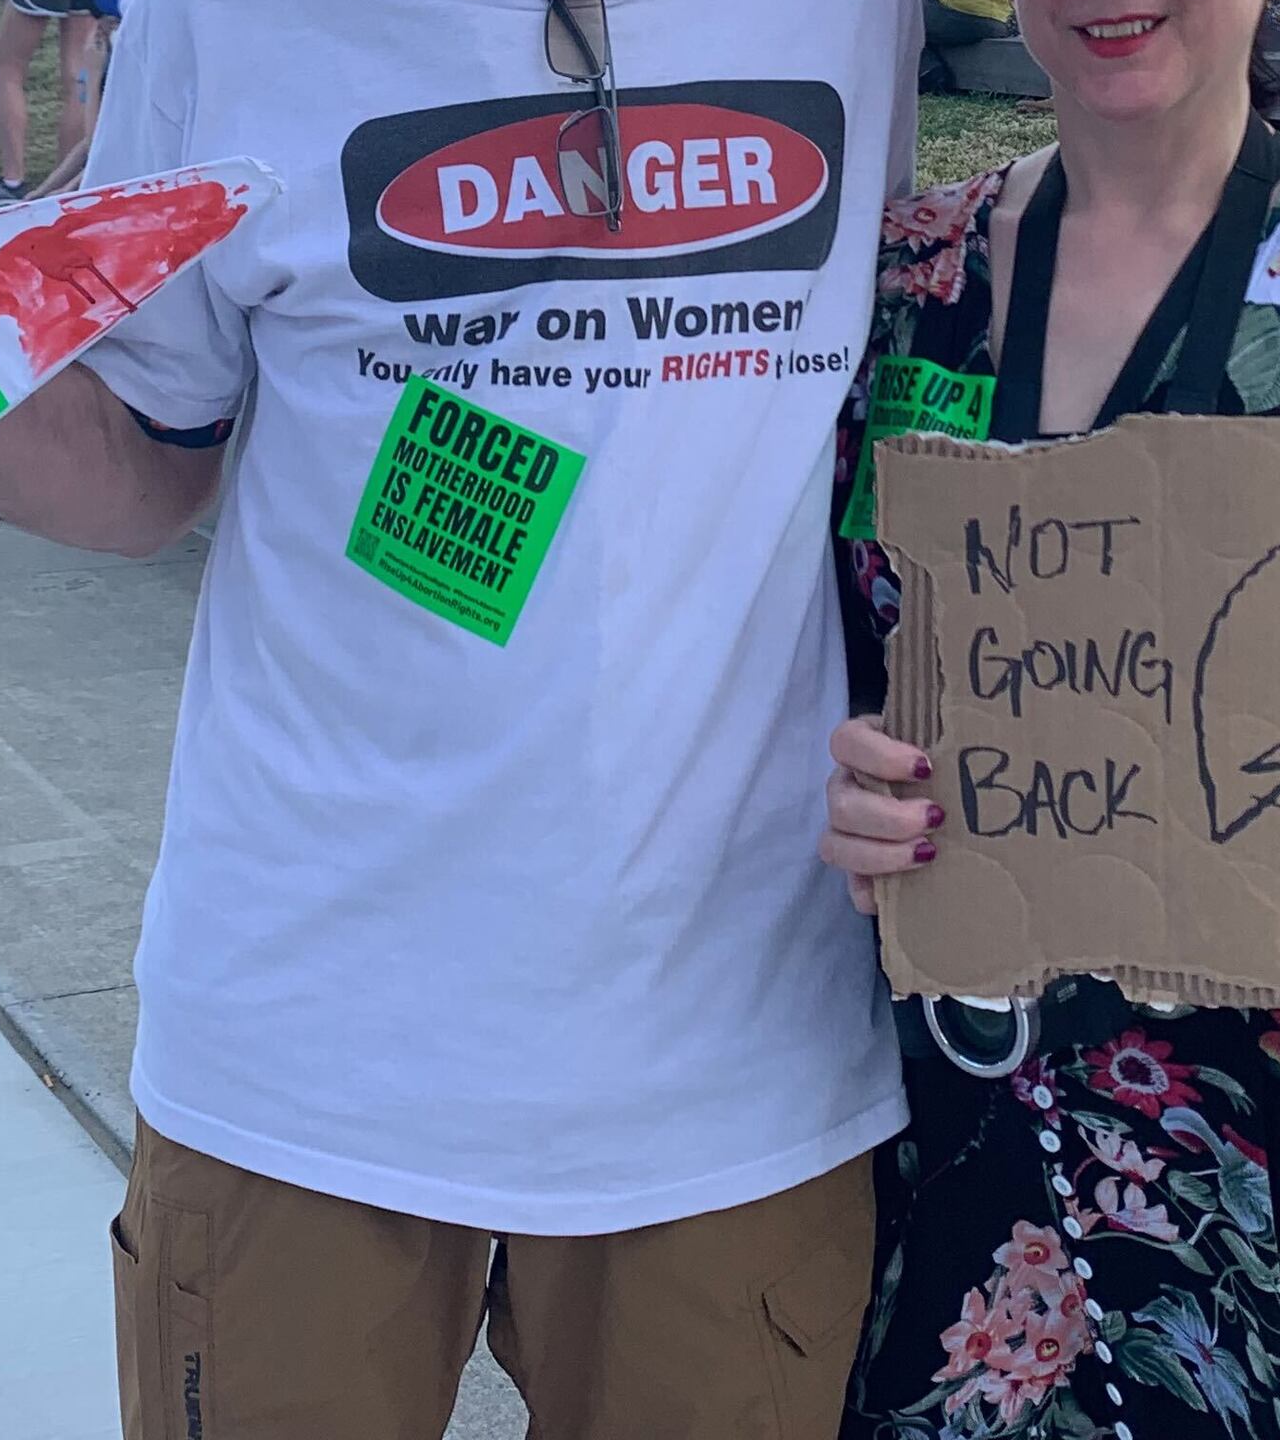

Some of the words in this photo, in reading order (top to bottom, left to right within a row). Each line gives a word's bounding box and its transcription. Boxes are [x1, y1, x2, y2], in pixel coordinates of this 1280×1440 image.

[436, 135, 778, 235] DANGER
[357, 348, 413, 384] You
[491, 358, 572, 388] have
[584, 363, 651, 394] your
[661, 348, 770, 383] RIGHTS
[789, 345, 849, 375] lose!
[403, 310, 520, 347] War
[536, 308, 607, 341] on
[876, 363, 922, 403] RISE
[921, 372, 966, 413] UP
[967, 383, 984, 423] 4
[392, 435, 537, 525] MOTHERHOOD
[408, 387, 560, 494] FORCED
[370, 502, 514, 594] ENSLAVEMENT
[380, 466, 412, 507] IS
[413, 486, 529, 565] FEMALE
[963, 504, 1142, 595] NOT
[968, 625, 1174, 726] GOING
[959, 745, 1158, 841] BACK
